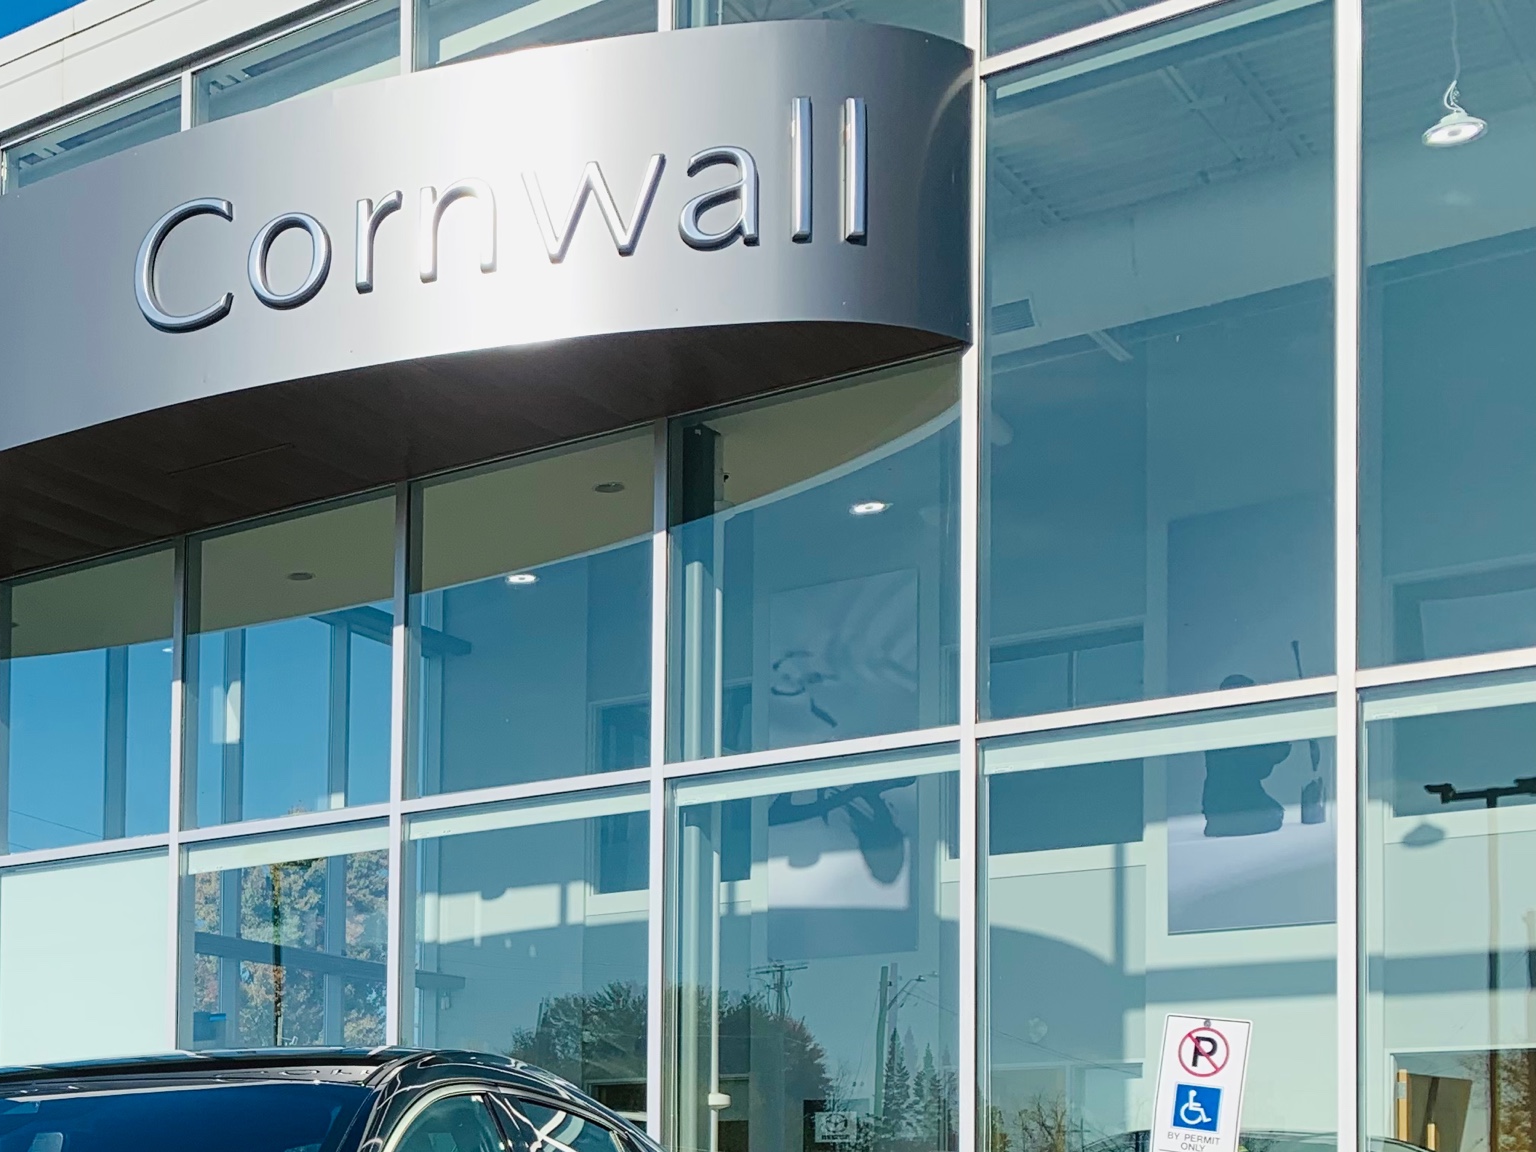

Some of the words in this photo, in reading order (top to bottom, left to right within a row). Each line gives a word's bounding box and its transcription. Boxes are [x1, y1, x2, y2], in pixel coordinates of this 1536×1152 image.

[134, 96, 868, 333] Cornwall
[1167, 1131, 1180, 1140] BY
[1184, 1134, 1221, 1145] PERMIT
[1180, 1142, 1206, 1152] ONLY
